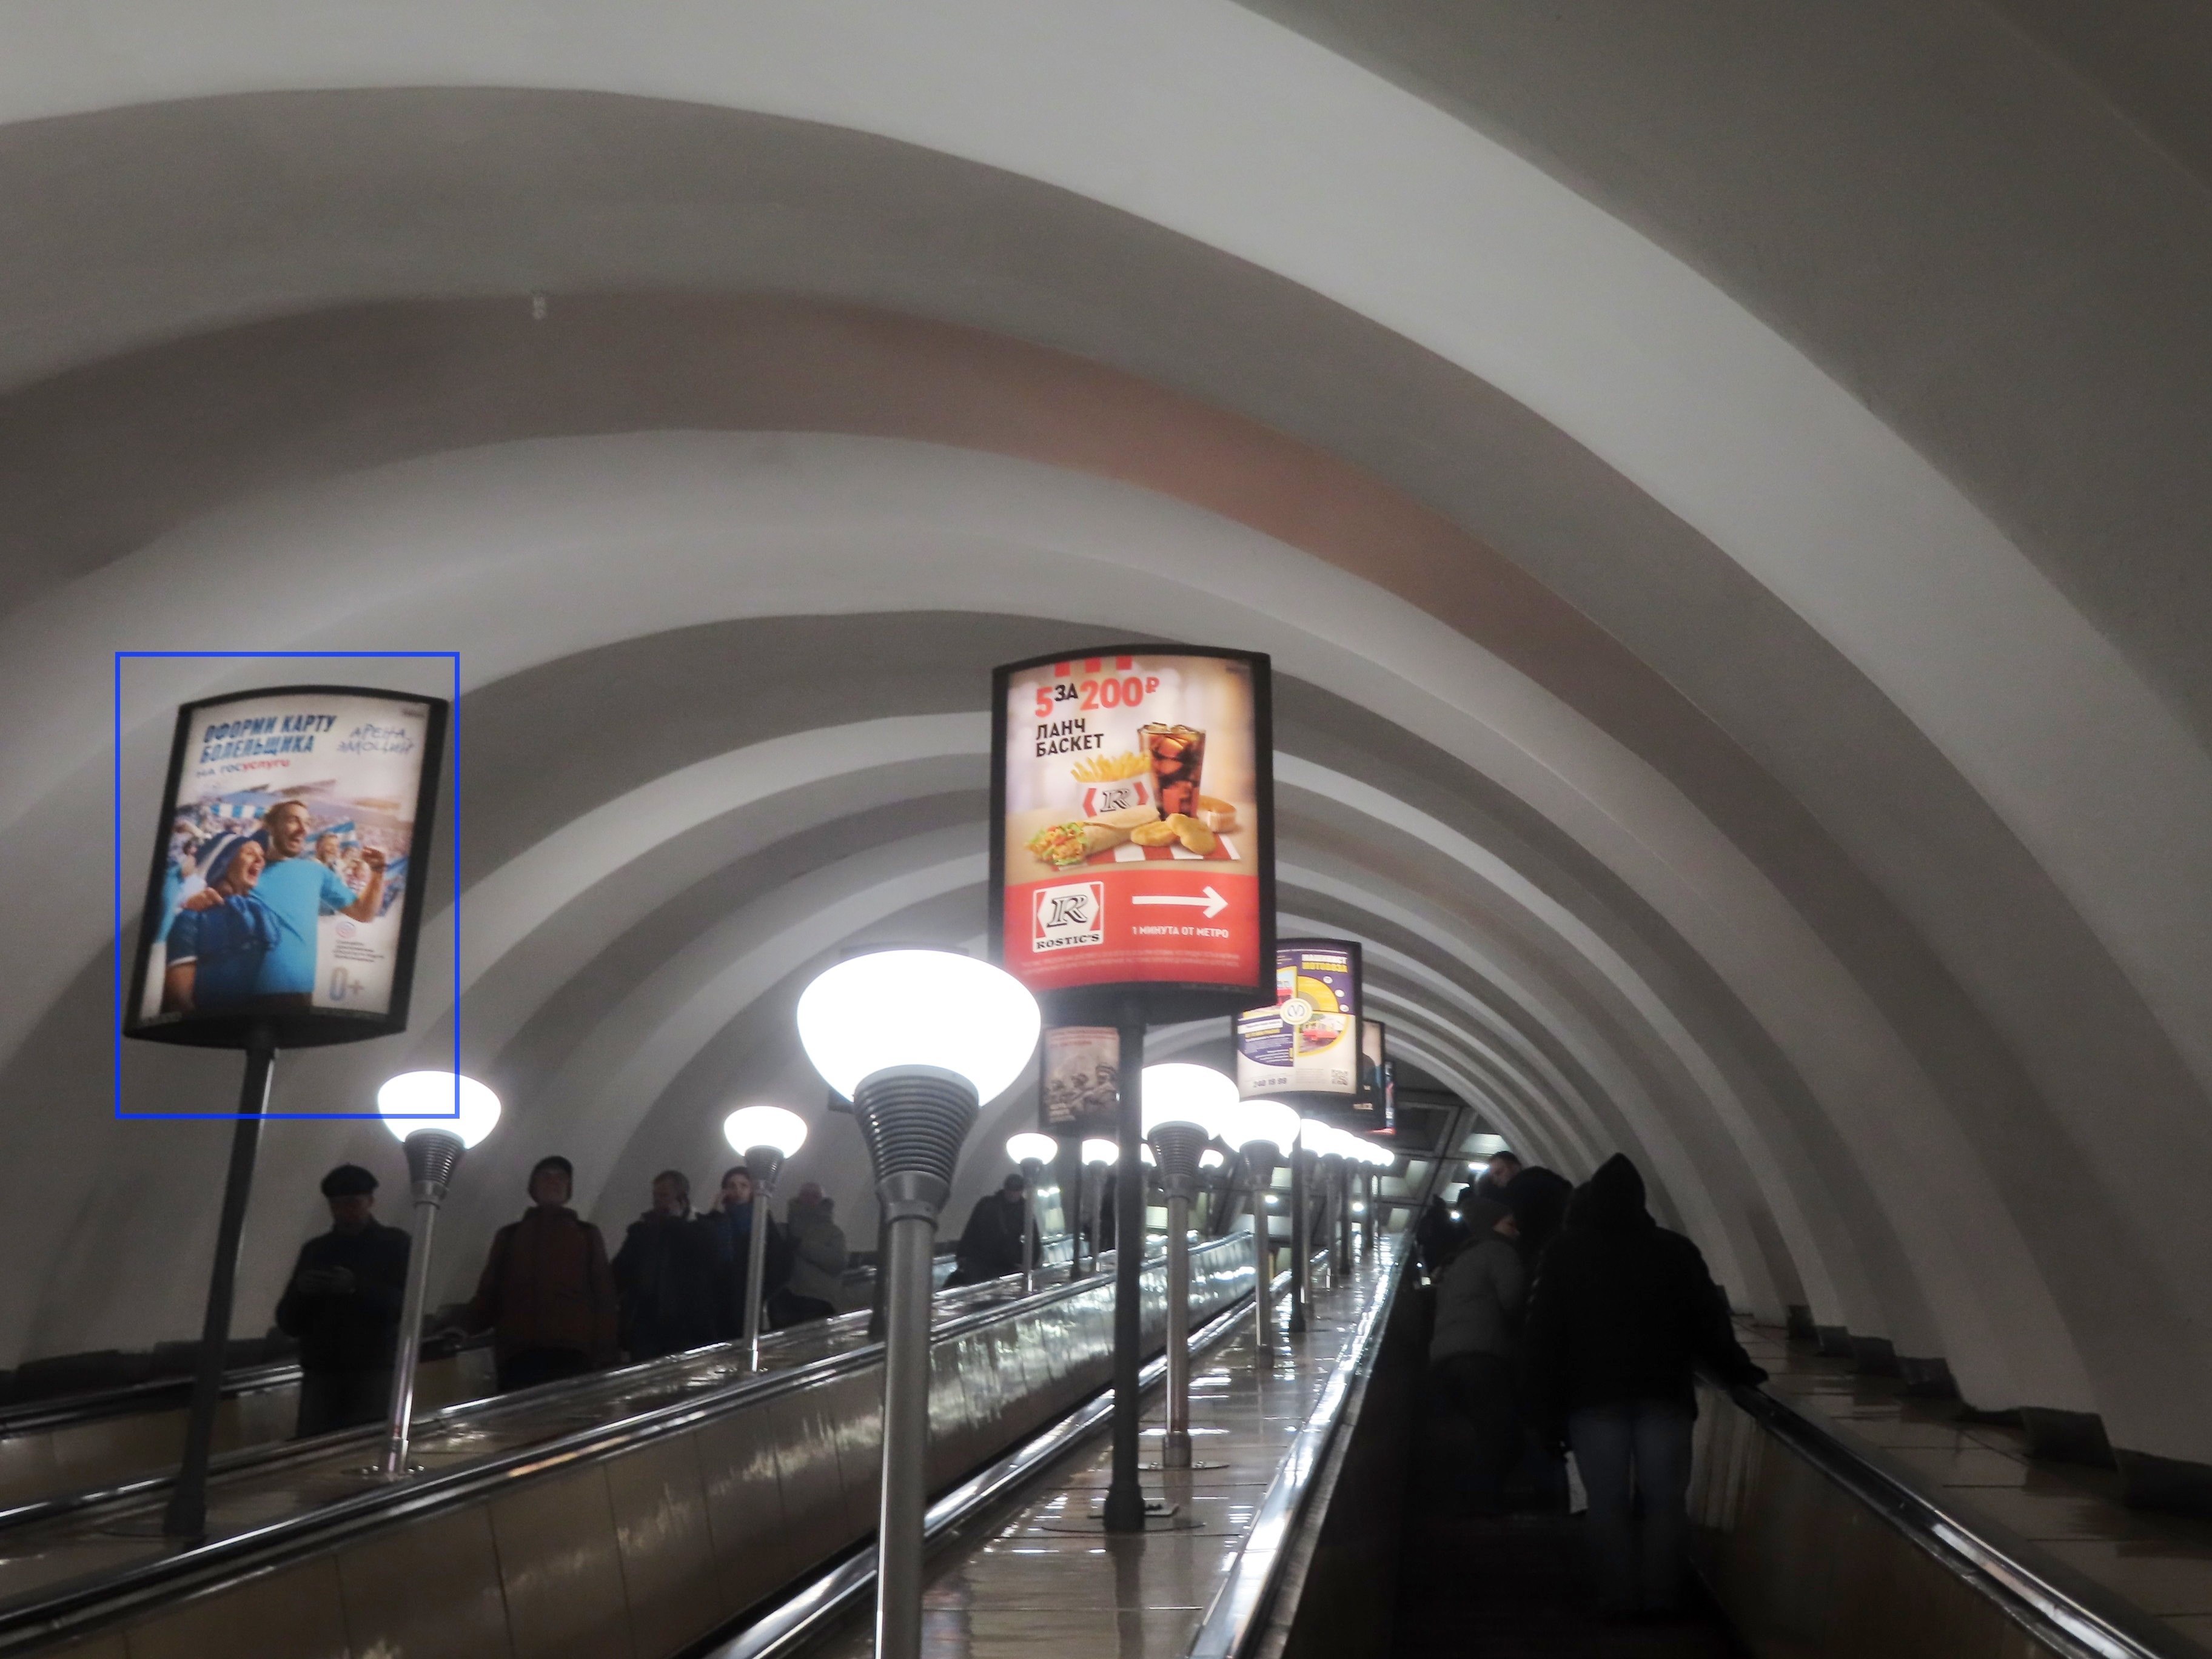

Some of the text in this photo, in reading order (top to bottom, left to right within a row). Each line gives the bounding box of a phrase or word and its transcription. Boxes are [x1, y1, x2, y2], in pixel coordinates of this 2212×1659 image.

[1035, 686, 1054, 718] 5
[1054, 682, 1079, 702] ЗА
[203, 714, 338, 743] ОФОРМИ КАРТУ
[1036, 718, 1086, 740] ЛАНЧ
[199, 734, 315, 764] БОЛЕЛЬЩИКА
[1036, 733, 1105, 757] БАСКЕТ
[1036, 933, 1102, 950] ROSTIC'S
[1139, 926, 1180, 936] МИНУТА
[1181, 927, 1195, 937] ОТ
[1196, 927, 1230, 939] МЕТРО
